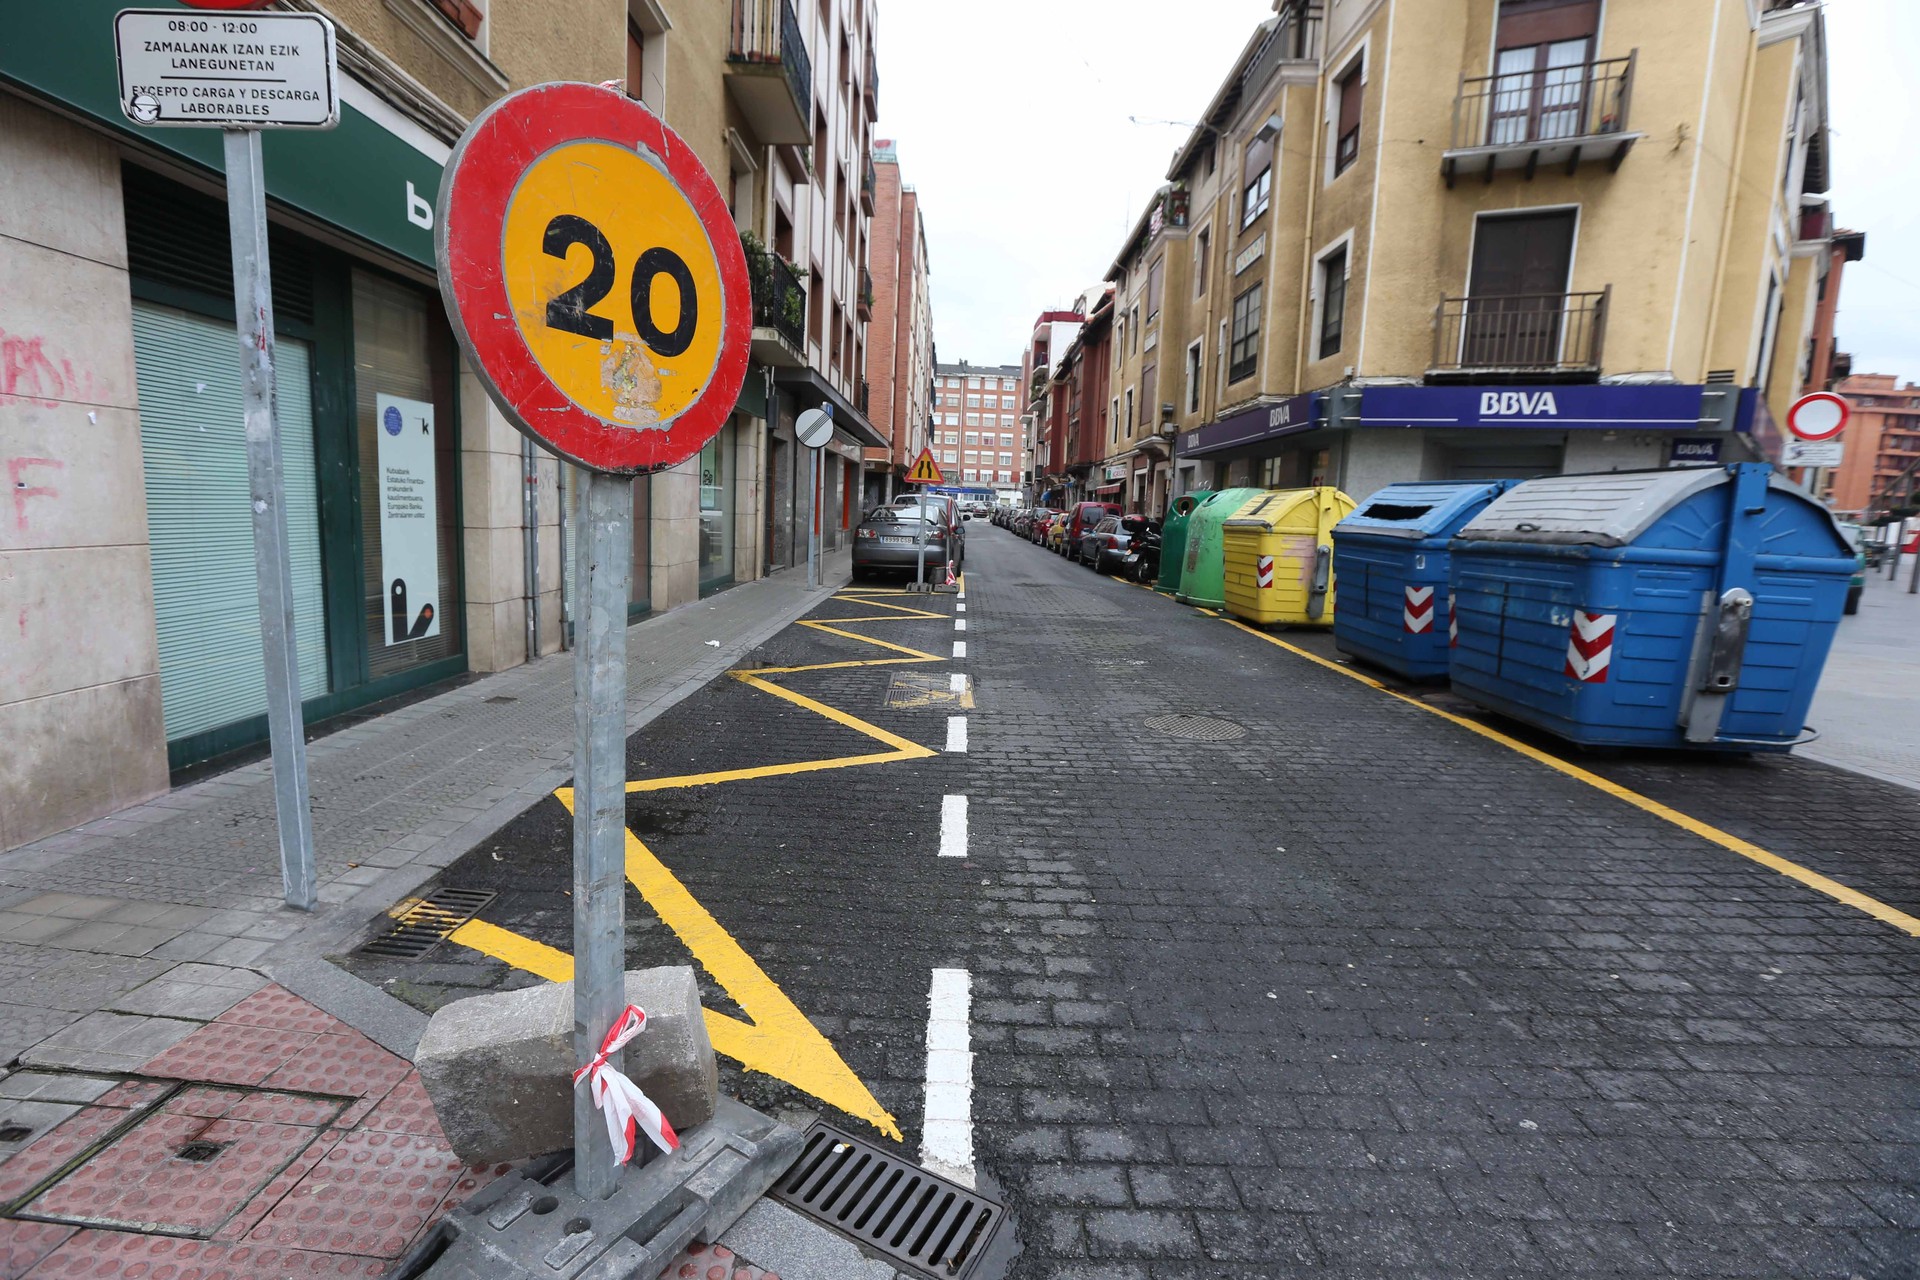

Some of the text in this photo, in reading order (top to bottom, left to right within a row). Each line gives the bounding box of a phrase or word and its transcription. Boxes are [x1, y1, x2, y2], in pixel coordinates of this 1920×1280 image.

[168, 20, 208, 32] 08:00
[222, 22, 258, 34] 12:00
[144, 41, 300, 57] ZAMALANAK IZAN EZIK
[171, 58, 275, 71] LANEGUNETAN
[132, 85, 320, 101] EXCEPTO CARGA Y DESCARGA
[181, 103, 270, 116] LABORABLES
[542, 214, 698, 357] 20
[1479, 391, 1558, 415] BBVA
[1269, 404, 1290, 428] BBVA
[1676, 443, 1715, 456] BBVA
